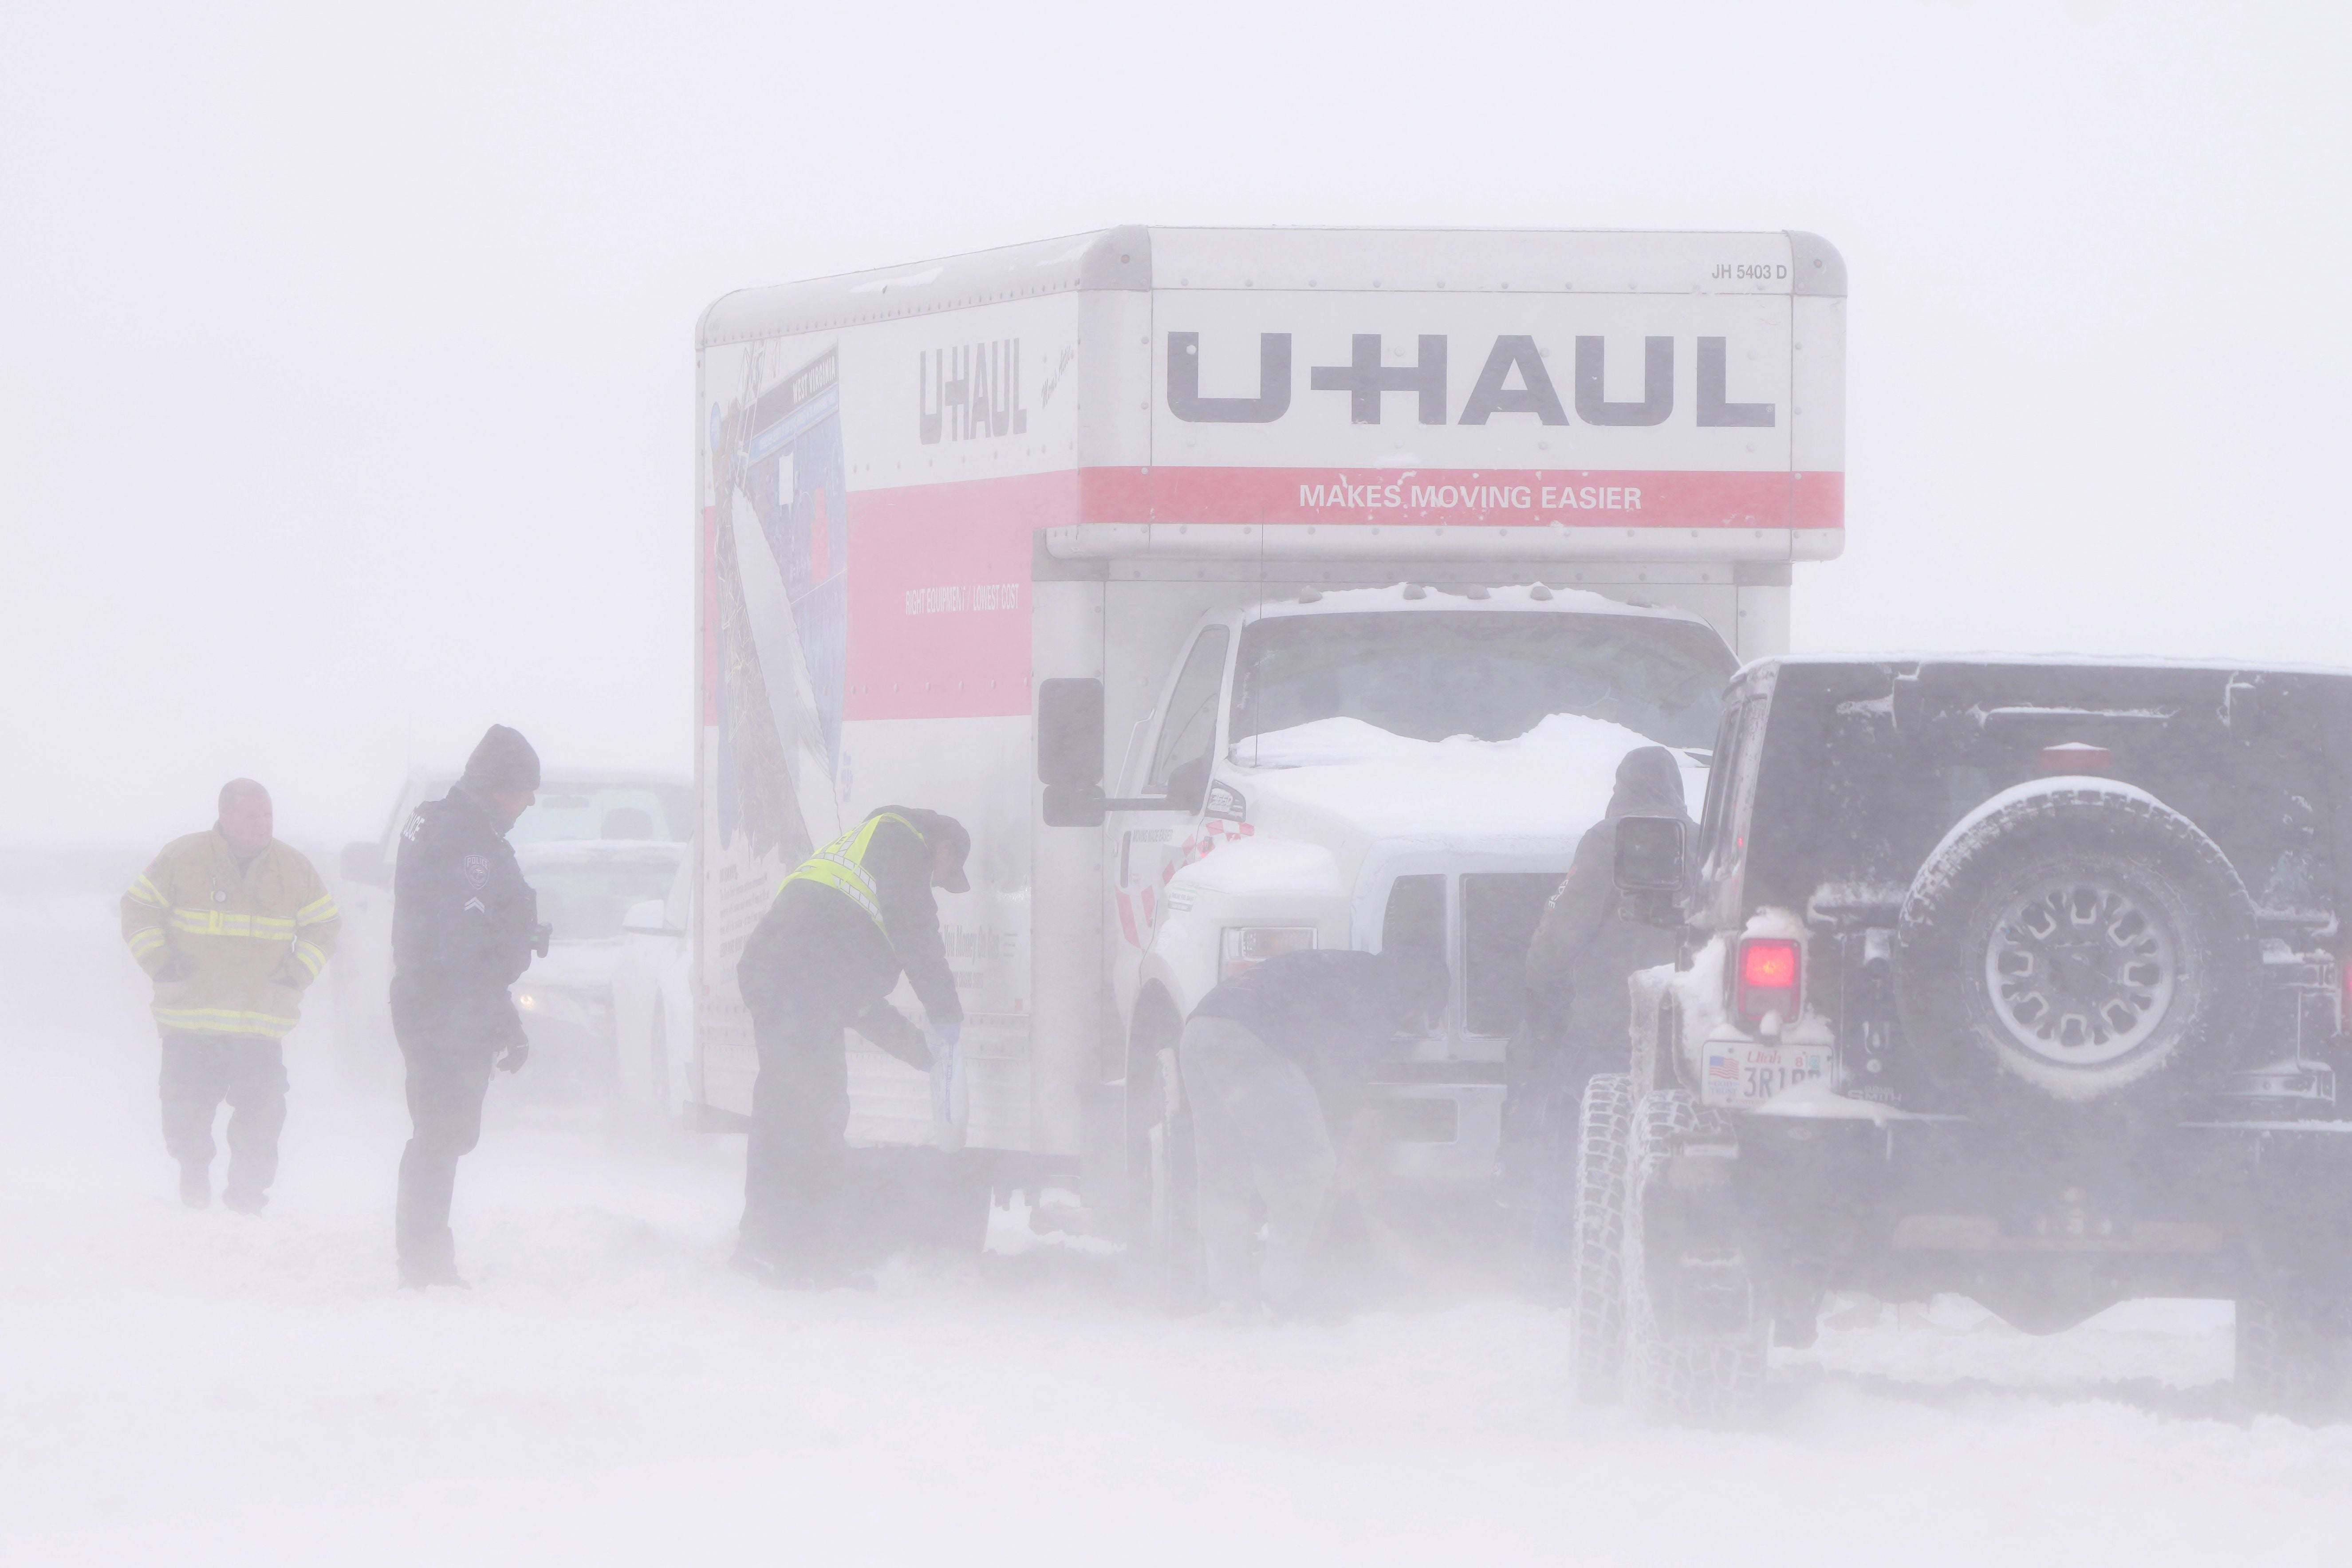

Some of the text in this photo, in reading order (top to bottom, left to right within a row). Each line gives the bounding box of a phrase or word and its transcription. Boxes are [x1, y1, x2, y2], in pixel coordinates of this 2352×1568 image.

[1712, 264, 1788, 280] JH 5403 D
[792, 355, 836, 405] WEST VIRGINIA
[920, 337, 1027, 445] U-HAUL
[1167, 331, 1776, 427] U-HAUL
[1299, 484, 1643, 510] MAKES MOVING EASIER
[905, 588, 926, 615] RIGHT
[926, 586, 965, 613] EQUIPMENT
[973, 584, 1000, 611] LOWEST
[1001, 583, 1020, 610] COST
[1132, 829, 1174, 843] MOVING MADE EASIER
[467, 856, 489, 871] POLICE
[955, 925, 977, 965] Money
[1747, 1050, 1782, 1064] Utah
